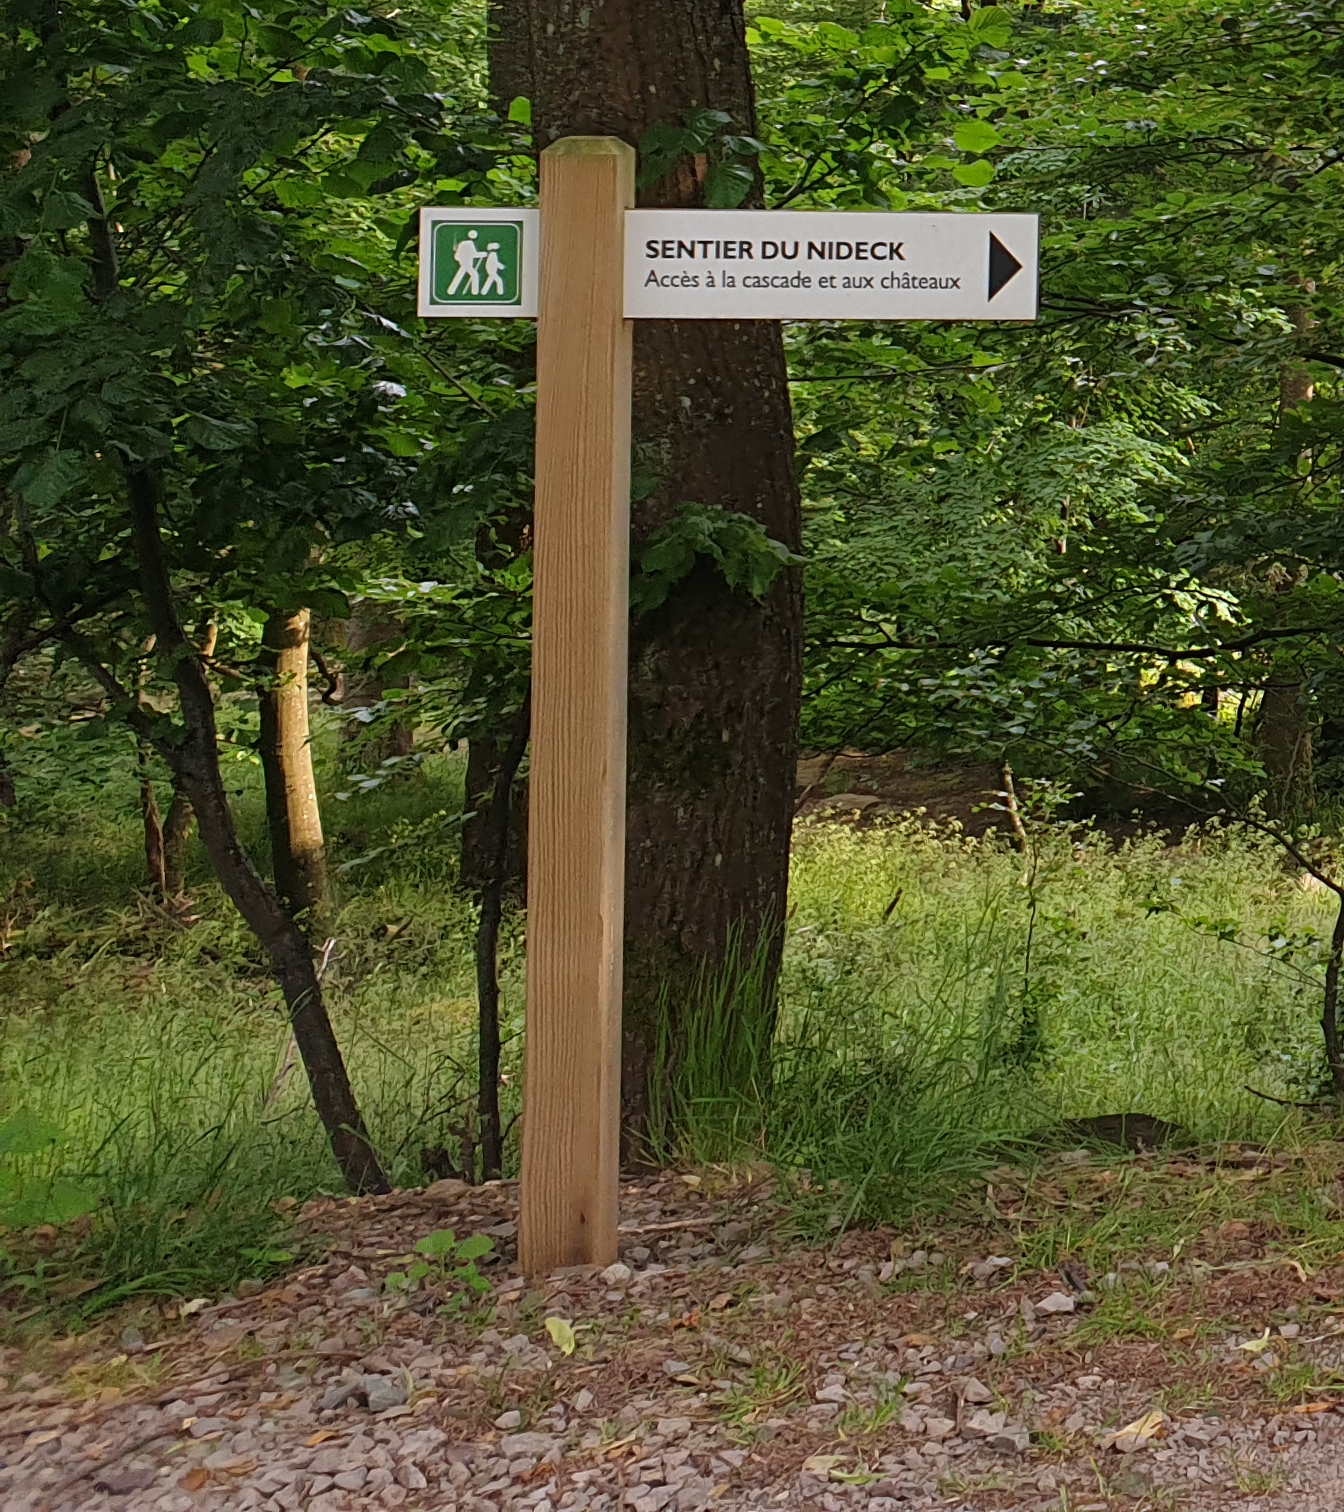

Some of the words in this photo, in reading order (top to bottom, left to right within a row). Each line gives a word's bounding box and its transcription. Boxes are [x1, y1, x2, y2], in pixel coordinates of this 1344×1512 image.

[645, 239, 754, 260] SENTIER
[761, 240, 800, 260] DU
[807, 241, 906, 261] NIDECK
[644, 269, 700, 288] Accès
[705, 271, 716, 288] à
[722, 270, 736, 288] la
[742, 270, 812, 289] cascade
[818, 274, 837, 289] et
[842, 275, 875, 289] aux
[880, 271, 962, 290] châteaux
